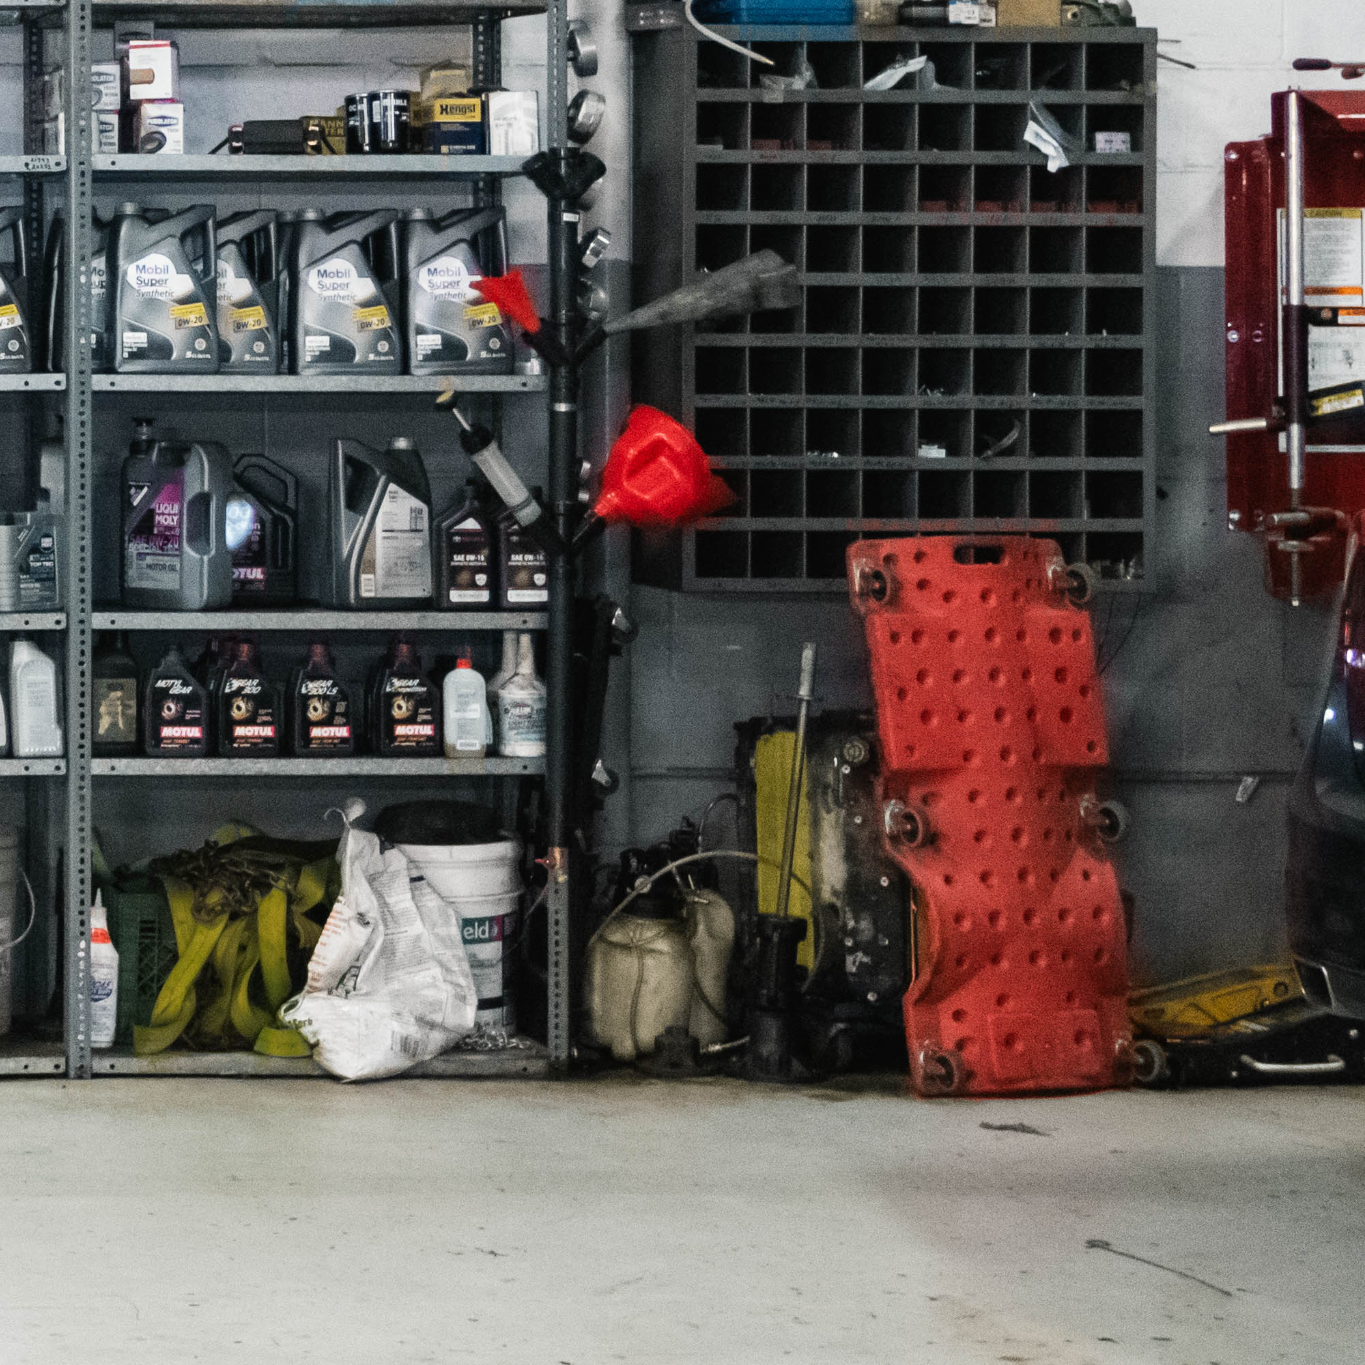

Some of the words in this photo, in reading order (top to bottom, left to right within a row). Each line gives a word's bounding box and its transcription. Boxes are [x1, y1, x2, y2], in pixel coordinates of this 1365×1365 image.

[440, 104, 476, 116] Hengst
[135, 264, 169, 275] Mobil
[317, 269, 351, 279] Mobil
[427, 266, 461, 278] Mobil
[136, 276, 169, 287] Super
[317, 280, 350, 290] Super
[428, 278, 461, 289] Super
[136, 289, 175, 299] Synthetic
[318, 291, 357, 302] Synthetic
[429, 290, 467, 301] Synthetic
[177, 316, 203, 327] 0W-20
[155, 503, 179, 513] LIQUI
[155, 514, 179, 525] MOLY
[161, 727, 201, 737] MOTUL
[235, 727, 273, 736] MOTUL
[311, 727, 349, 737] MOTUL
[395, 725, 433, 735] MOTUL
